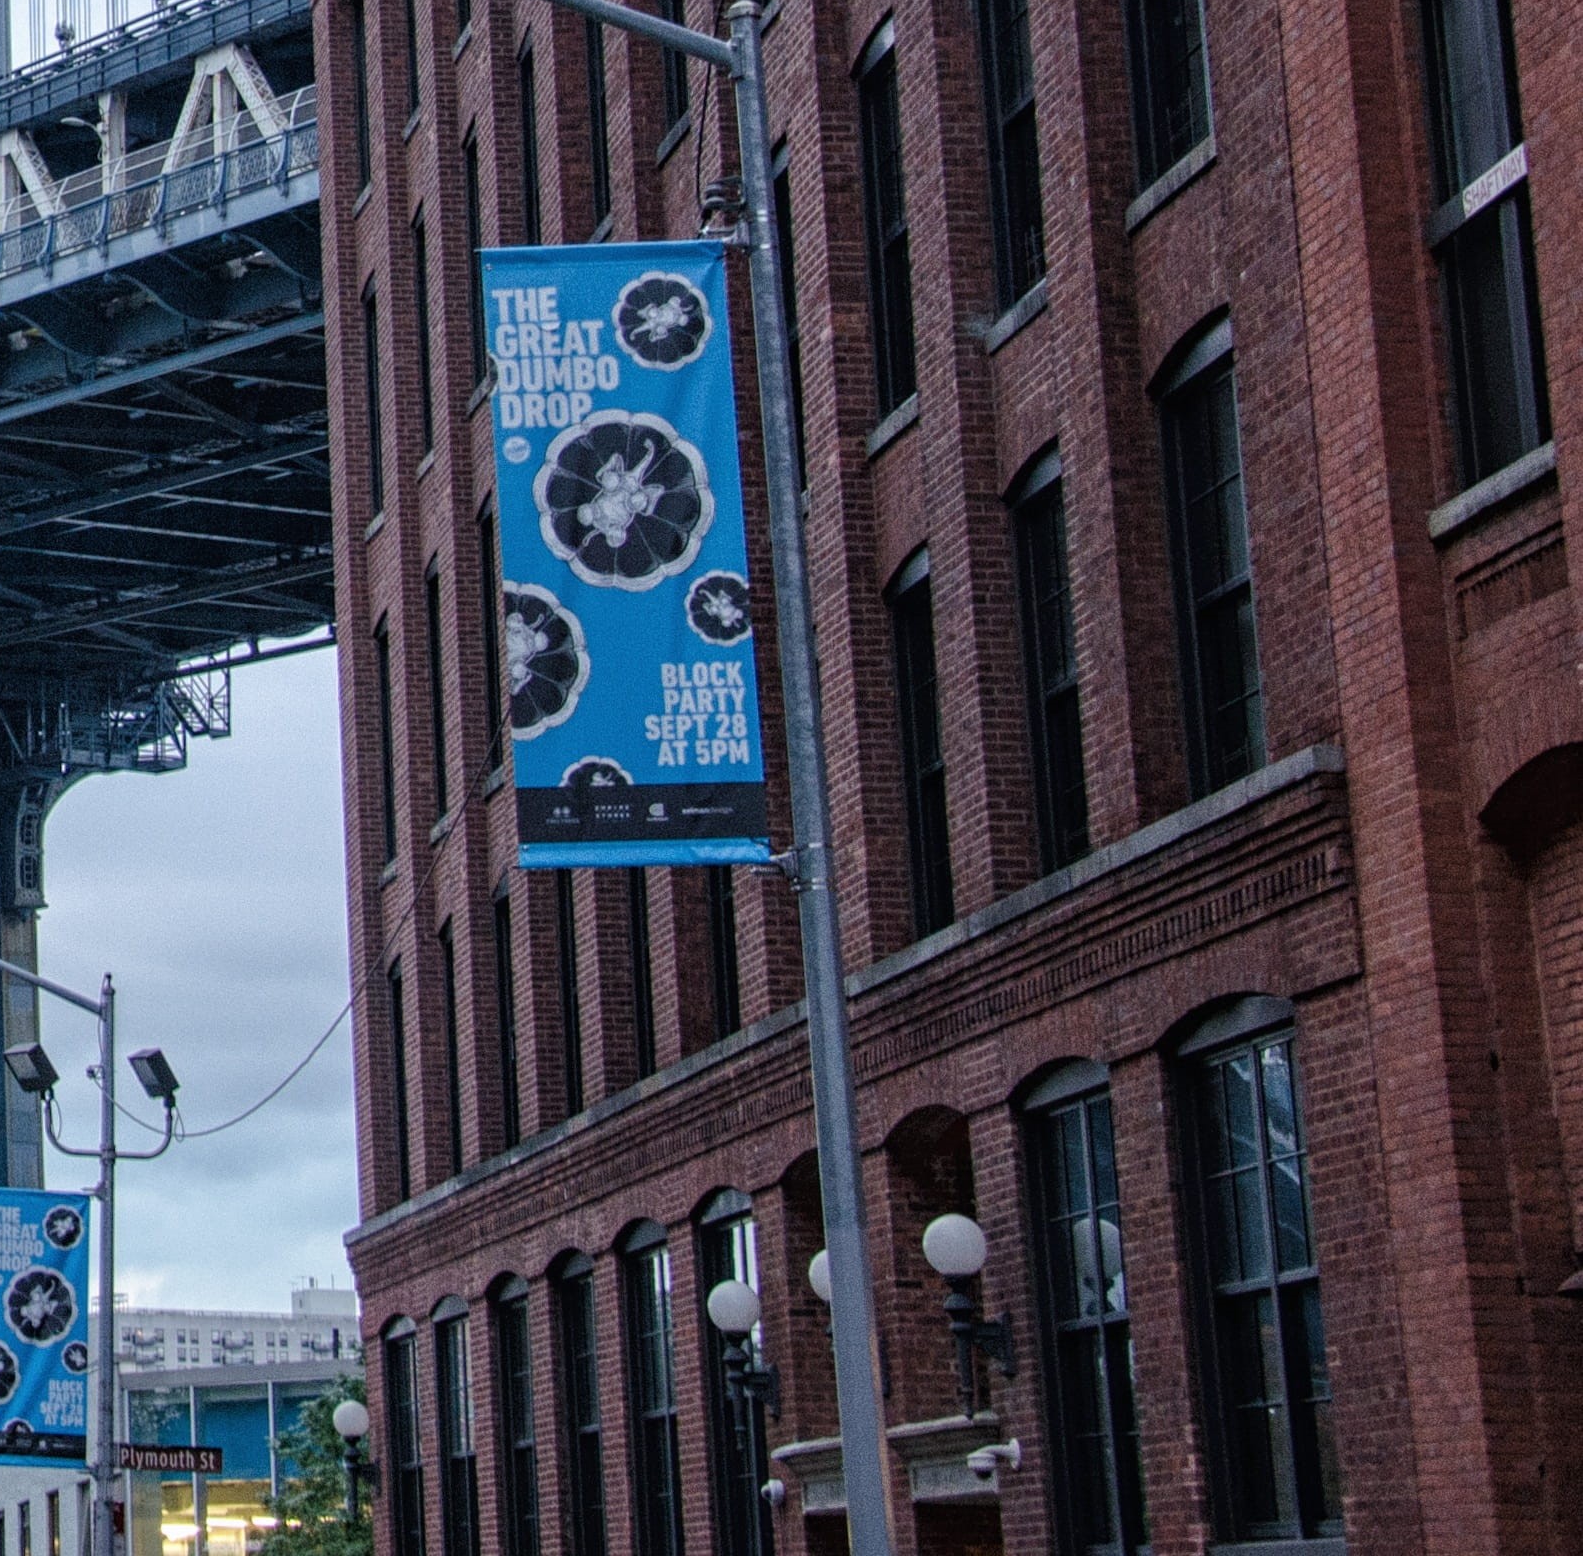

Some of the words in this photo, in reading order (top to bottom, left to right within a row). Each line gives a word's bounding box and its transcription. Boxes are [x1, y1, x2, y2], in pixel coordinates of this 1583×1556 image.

[1464, 148, 1523, 214] SHAFTWAY
[492, 287, 560, 322] THE
[495, 320, 604, 358] GREAT
[498, 355, 620, 392] DUMBO
[500, 392, 593, 428] DROP
[661, 661, 744, 688] BLOCK
[663, 687, 746, 714] PARTY
[645, 714, 709, 741] SEPT
[715, 713, 747, 738] 28
[658, 741, 688, 766] AT
[695, 739, 749, 765] 5PM
[49, 1391, 83, 1403] PARTY
[120, 1447, 194, 1470] Plymouth
[200, 1451, 215, 1470] St
